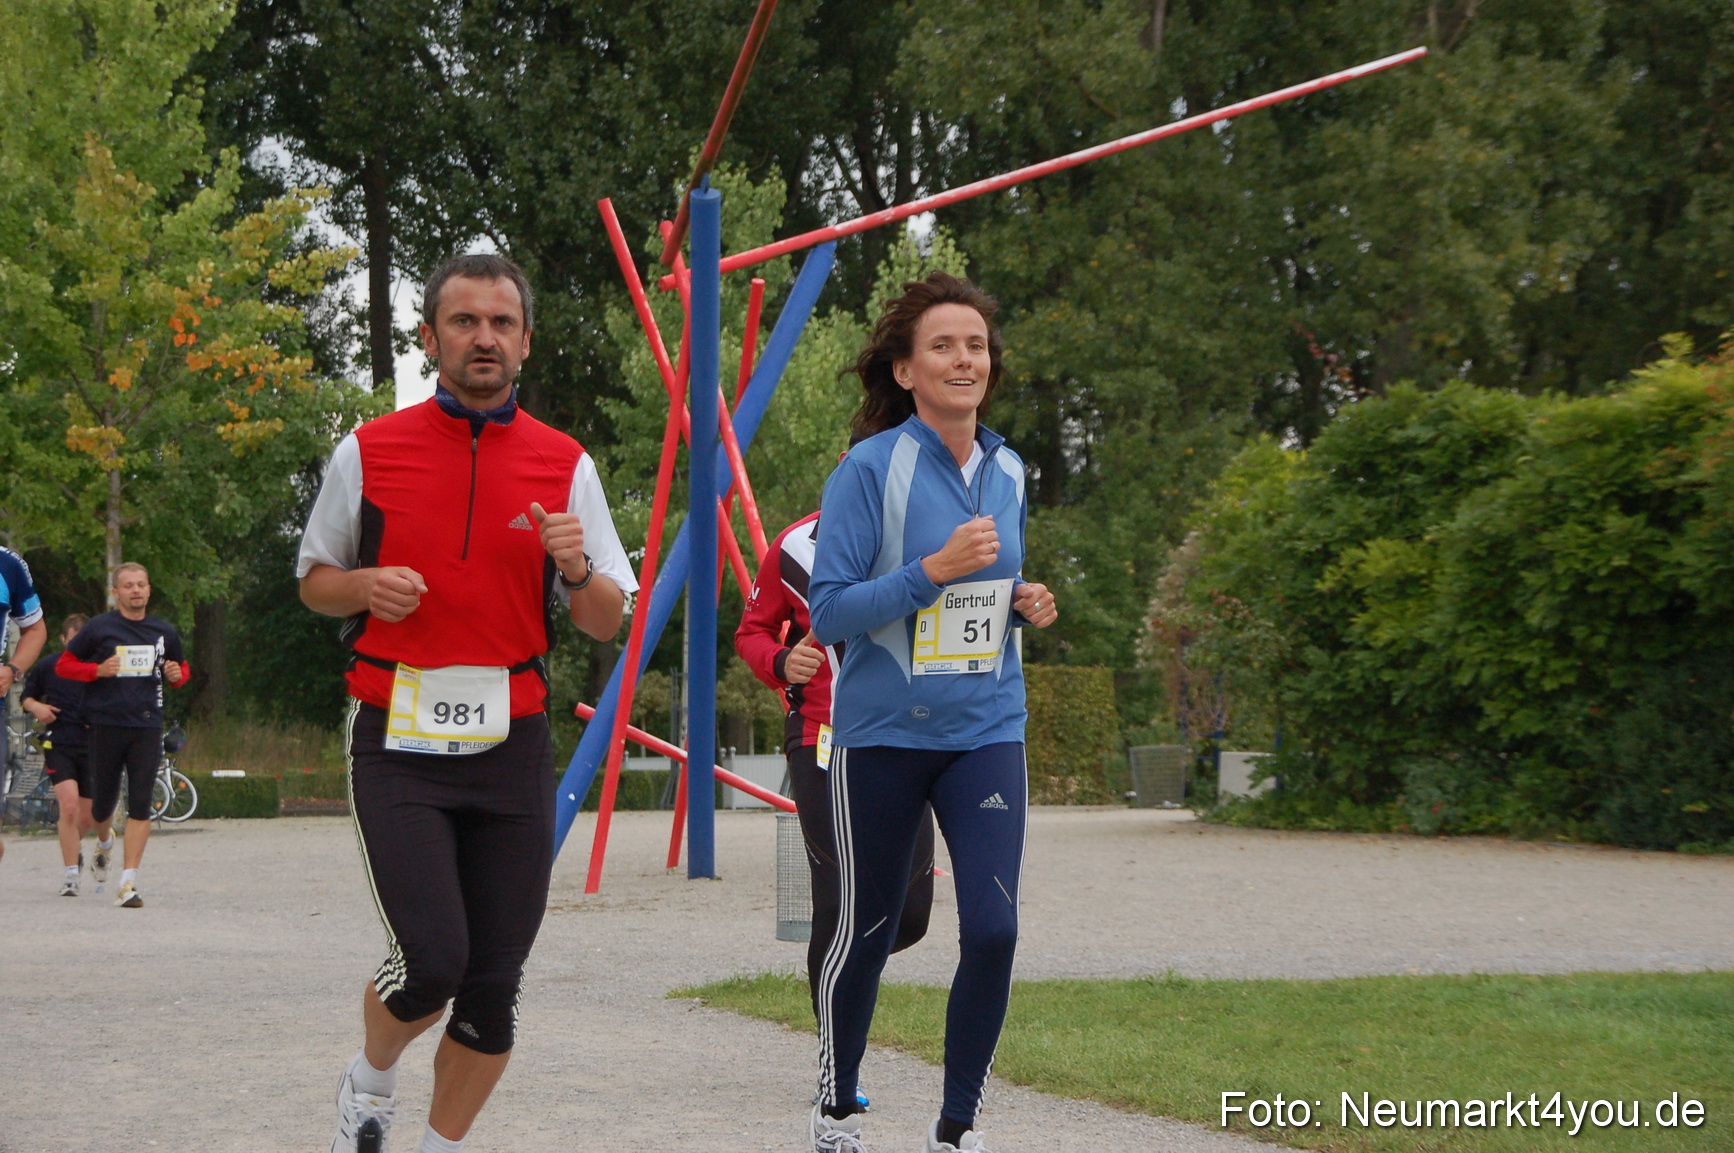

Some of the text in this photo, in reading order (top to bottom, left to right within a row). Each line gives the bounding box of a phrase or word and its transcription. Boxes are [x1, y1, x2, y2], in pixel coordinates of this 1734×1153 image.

[509, 522, 533, 530] adidas
[945, 589, 996, 609] Gertrud
[963, 618, 991, 643] 51
[131, 657, 149, 667] 651
[433, 701, 486, 726] 981
[979, 802, 1009, 810] adidas
